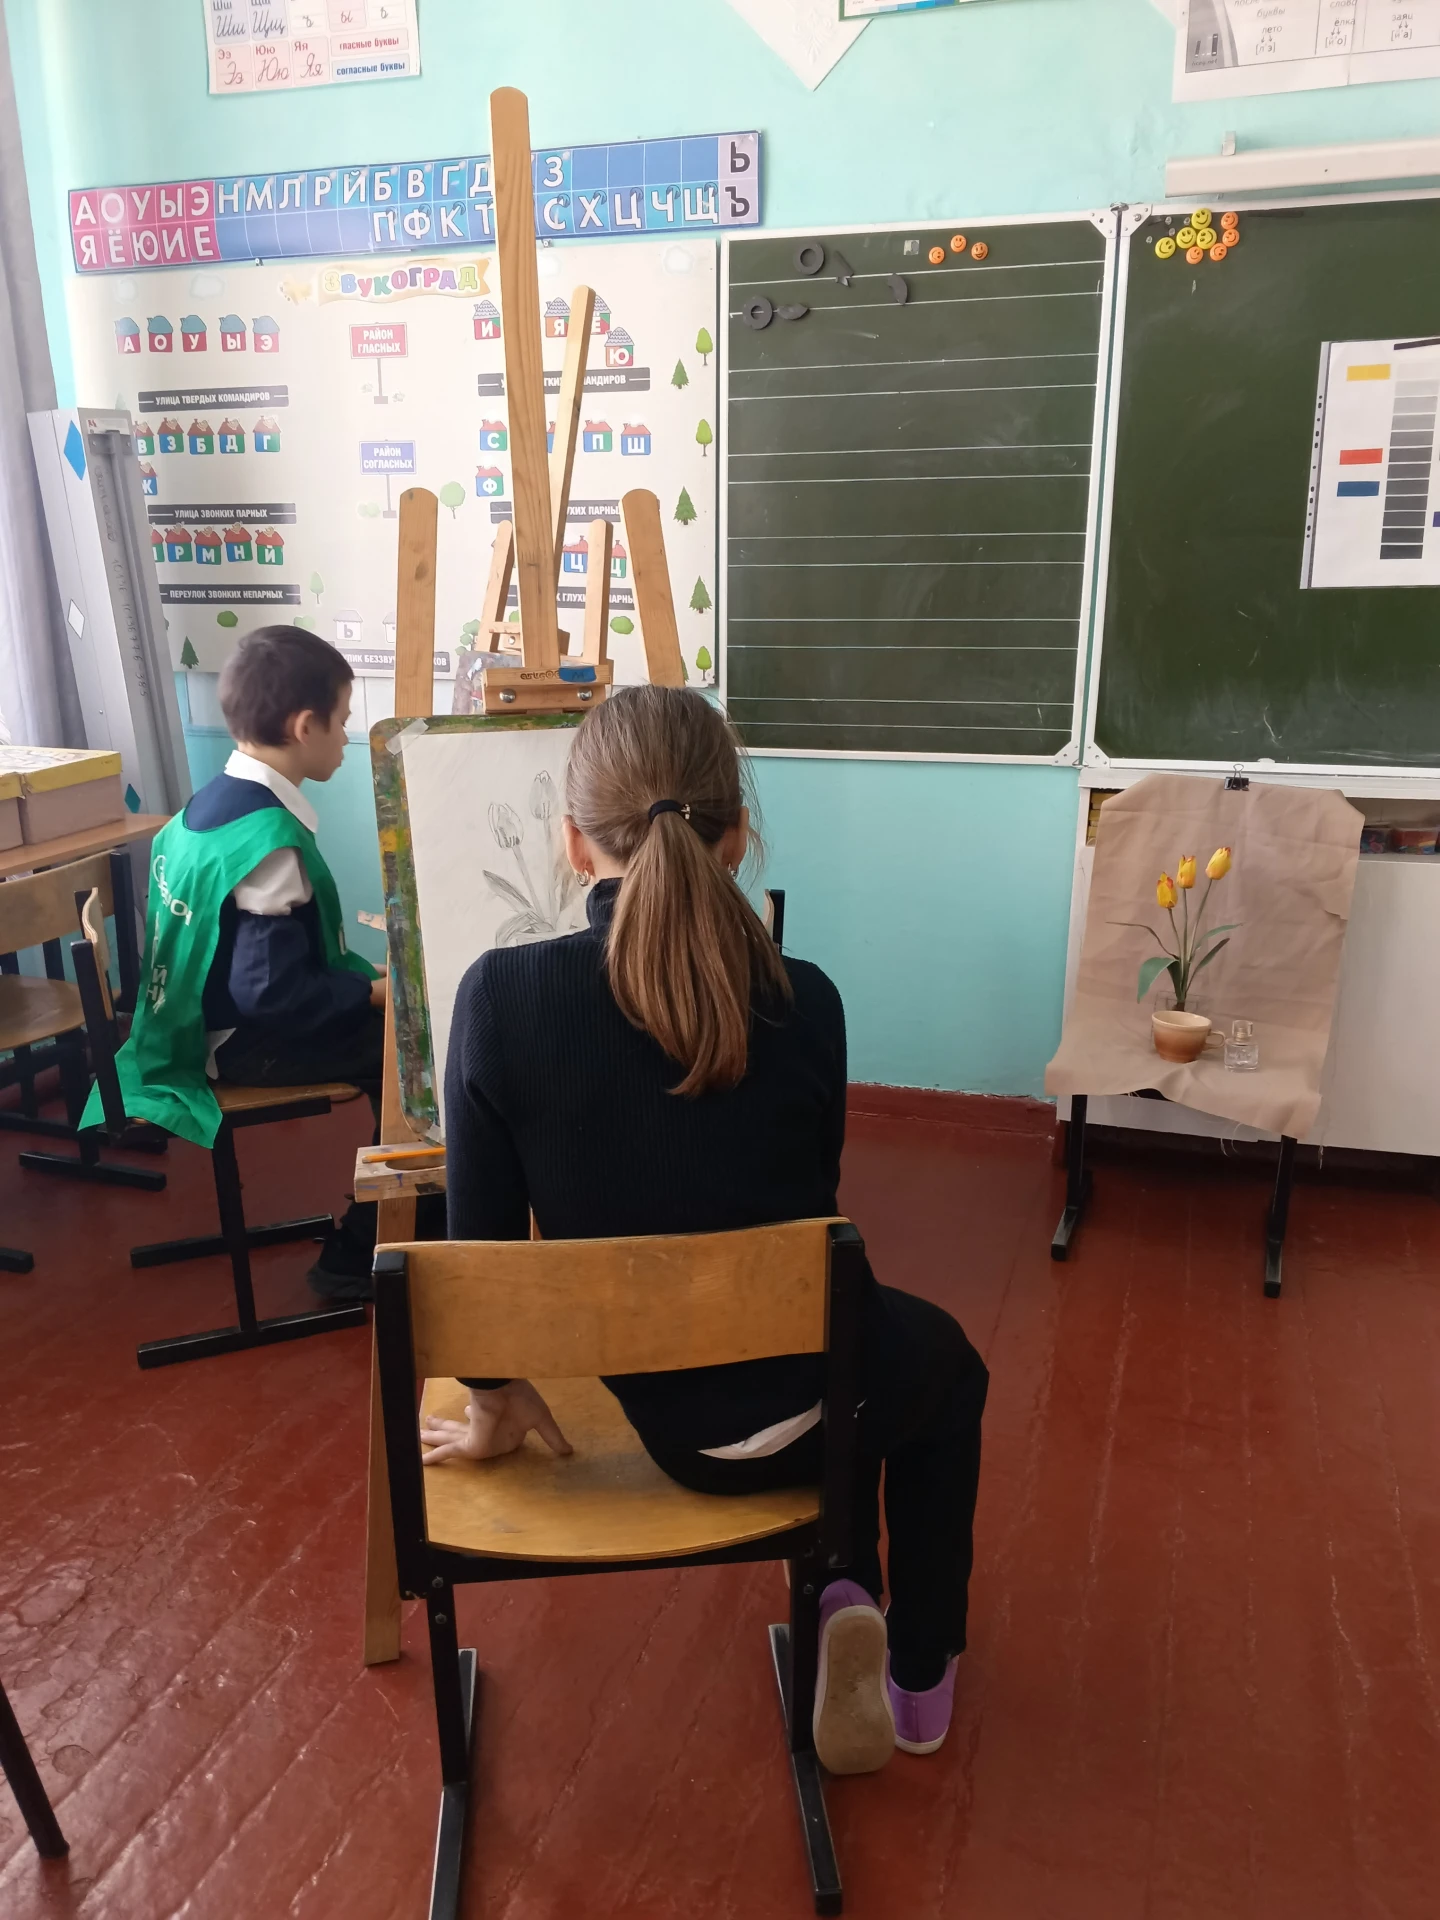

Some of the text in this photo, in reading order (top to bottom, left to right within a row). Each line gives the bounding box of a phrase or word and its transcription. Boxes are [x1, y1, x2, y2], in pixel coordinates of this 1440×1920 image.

[1256, 6, 1286, 19] буквы
[1261, 25, 1283, 34] лето
[339, 37, 400, 50] гласные буквы
[336, 62, 406, 76] согласные буквы
[324, 266, 478, 298] ЗВУКОГРАД
[363, 327, 394, 340] РАЙОН
[481, 321, 494, 337] И
[553, 319, 565, 335] Я
[123, 337, 135, 352] А
[154, 334, 167, 350] О
[188, 334, 199, 349] У
[226, 334, 241, 350] Ы
[260, 335, 273, 350] Э
[357, 342, 401, 354] ГЛАСНЫХ
[609, 348, 630, 364] Ю
[155, 391, 271, 406] УЛИЦА ТВЕРДЫХ КОМАНДИРОВ
[138, 439, 148, 454] В
[166, 436, 177, 451] З
[196, 438, 207, 453] Б
[226, 434, 239, 452] Д
[263, 435, 272, 450] Г
[487, 432, 500, 449] С
[592, 434, 604, 450] П
[627, 437, 645, 454] Ш
[373, 446, 402, 458] РАЙОН
[363, 459, 413, 470] СОГЛАСНЫХ
[482, 477, 498, 493] Ф
[174, 509, 268, 519] УЛИЦА ЗВОНКИХ ПАРНЫХ
[175, 545, 185, 560] Р
[202, 548, 215, 563] М
[234, 545, 245, 560] Н
[264, 545, 276, 563] Й
[571, 553, 584, 573] Ц
[169, 590, 284, 599] ПЕРЕУЛОК ЗВОНКИХ НЕПАРНЫХ
